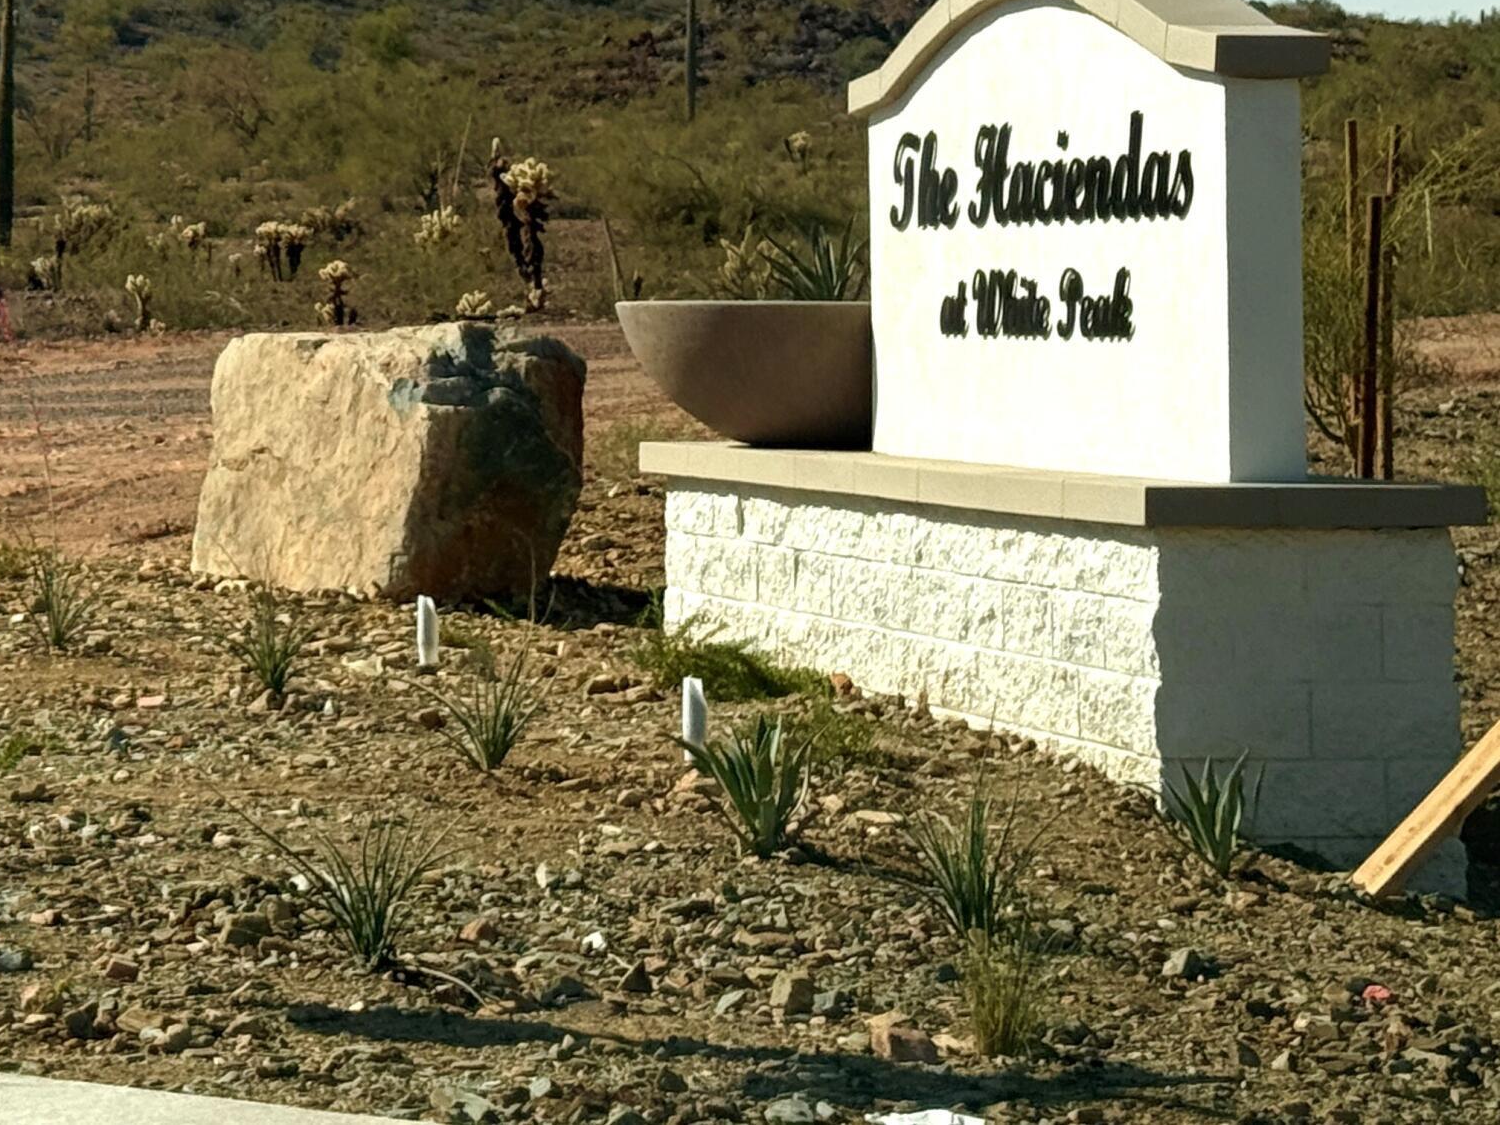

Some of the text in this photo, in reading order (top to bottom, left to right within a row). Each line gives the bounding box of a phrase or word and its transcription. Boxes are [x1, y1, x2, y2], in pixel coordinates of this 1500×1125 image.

[890, 110, 1194, 232] The Haciendas
[940, 266, 1135, 342] at White Peak
